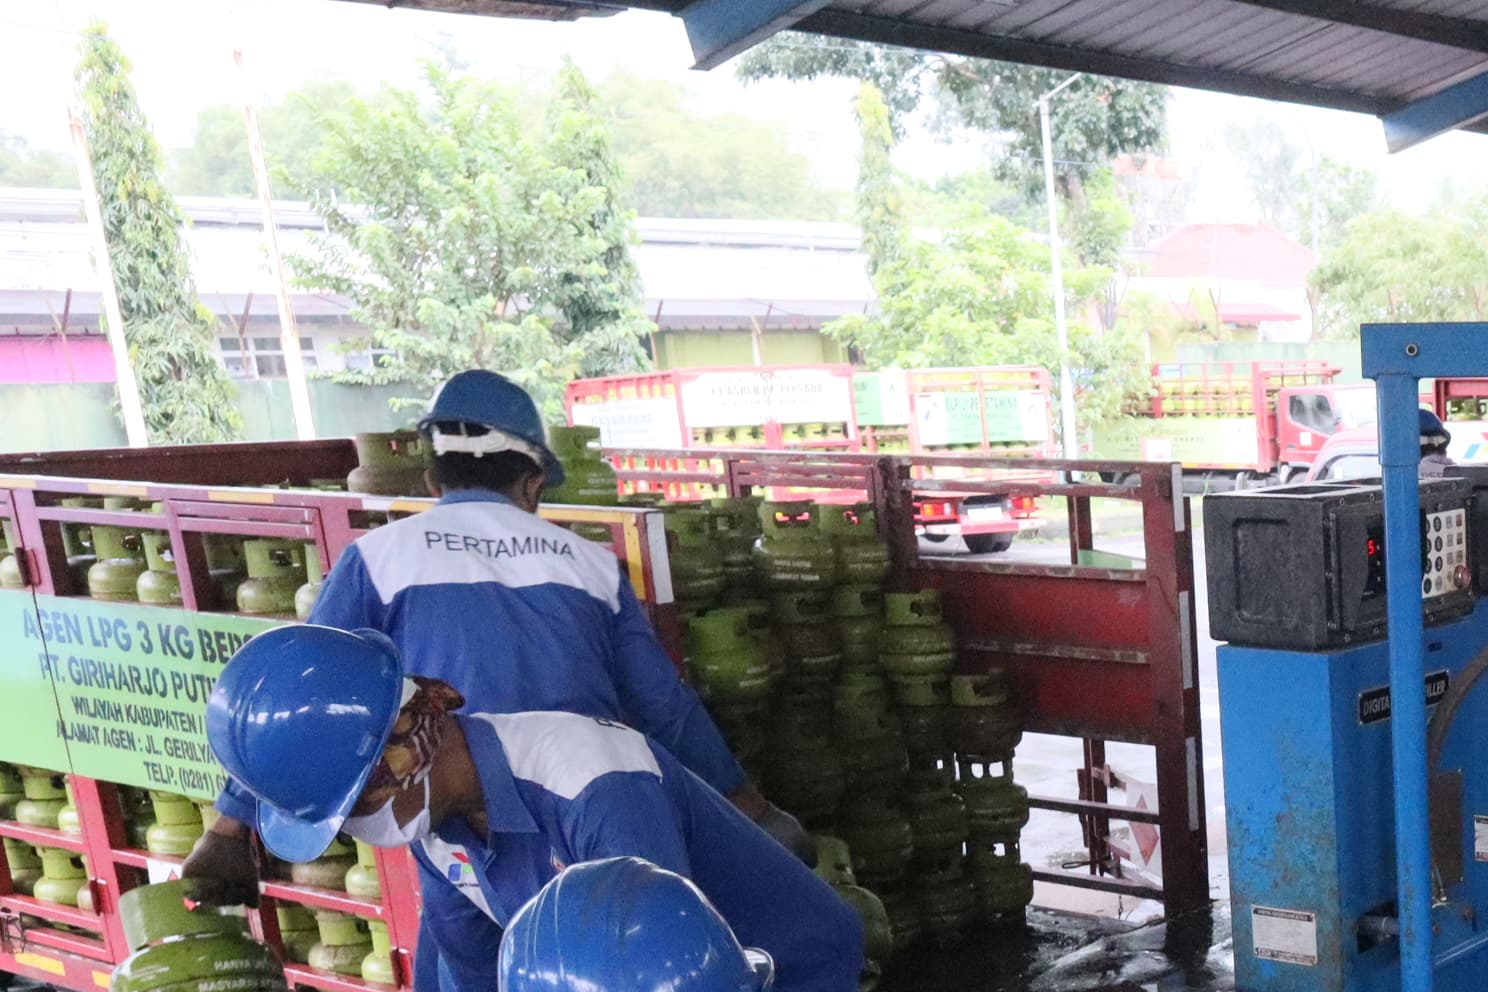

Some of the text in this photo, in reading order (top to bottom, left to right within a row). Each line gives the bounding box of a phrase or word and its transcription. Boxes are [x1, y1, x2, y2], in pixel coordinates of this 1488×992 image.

[424, 531, 576, 561] PERTAMINA
[22, 607, 254, 664] AGEN LPG 3 KG BER
[38, 652, 65, 681] PT.
[68, 653, 168, 699] GIRIHARJO
[71, 695, 124, 723] WILAYAH
[125, 703, 197, 735] KABUPATEN
[1363, 680, 1446, 717] DIGITA ILLER
[56, 719, 100, 745] ALAMAT
[103, 726, 137, 752] AGEN
[143, 760, 178, 786] TELP.
